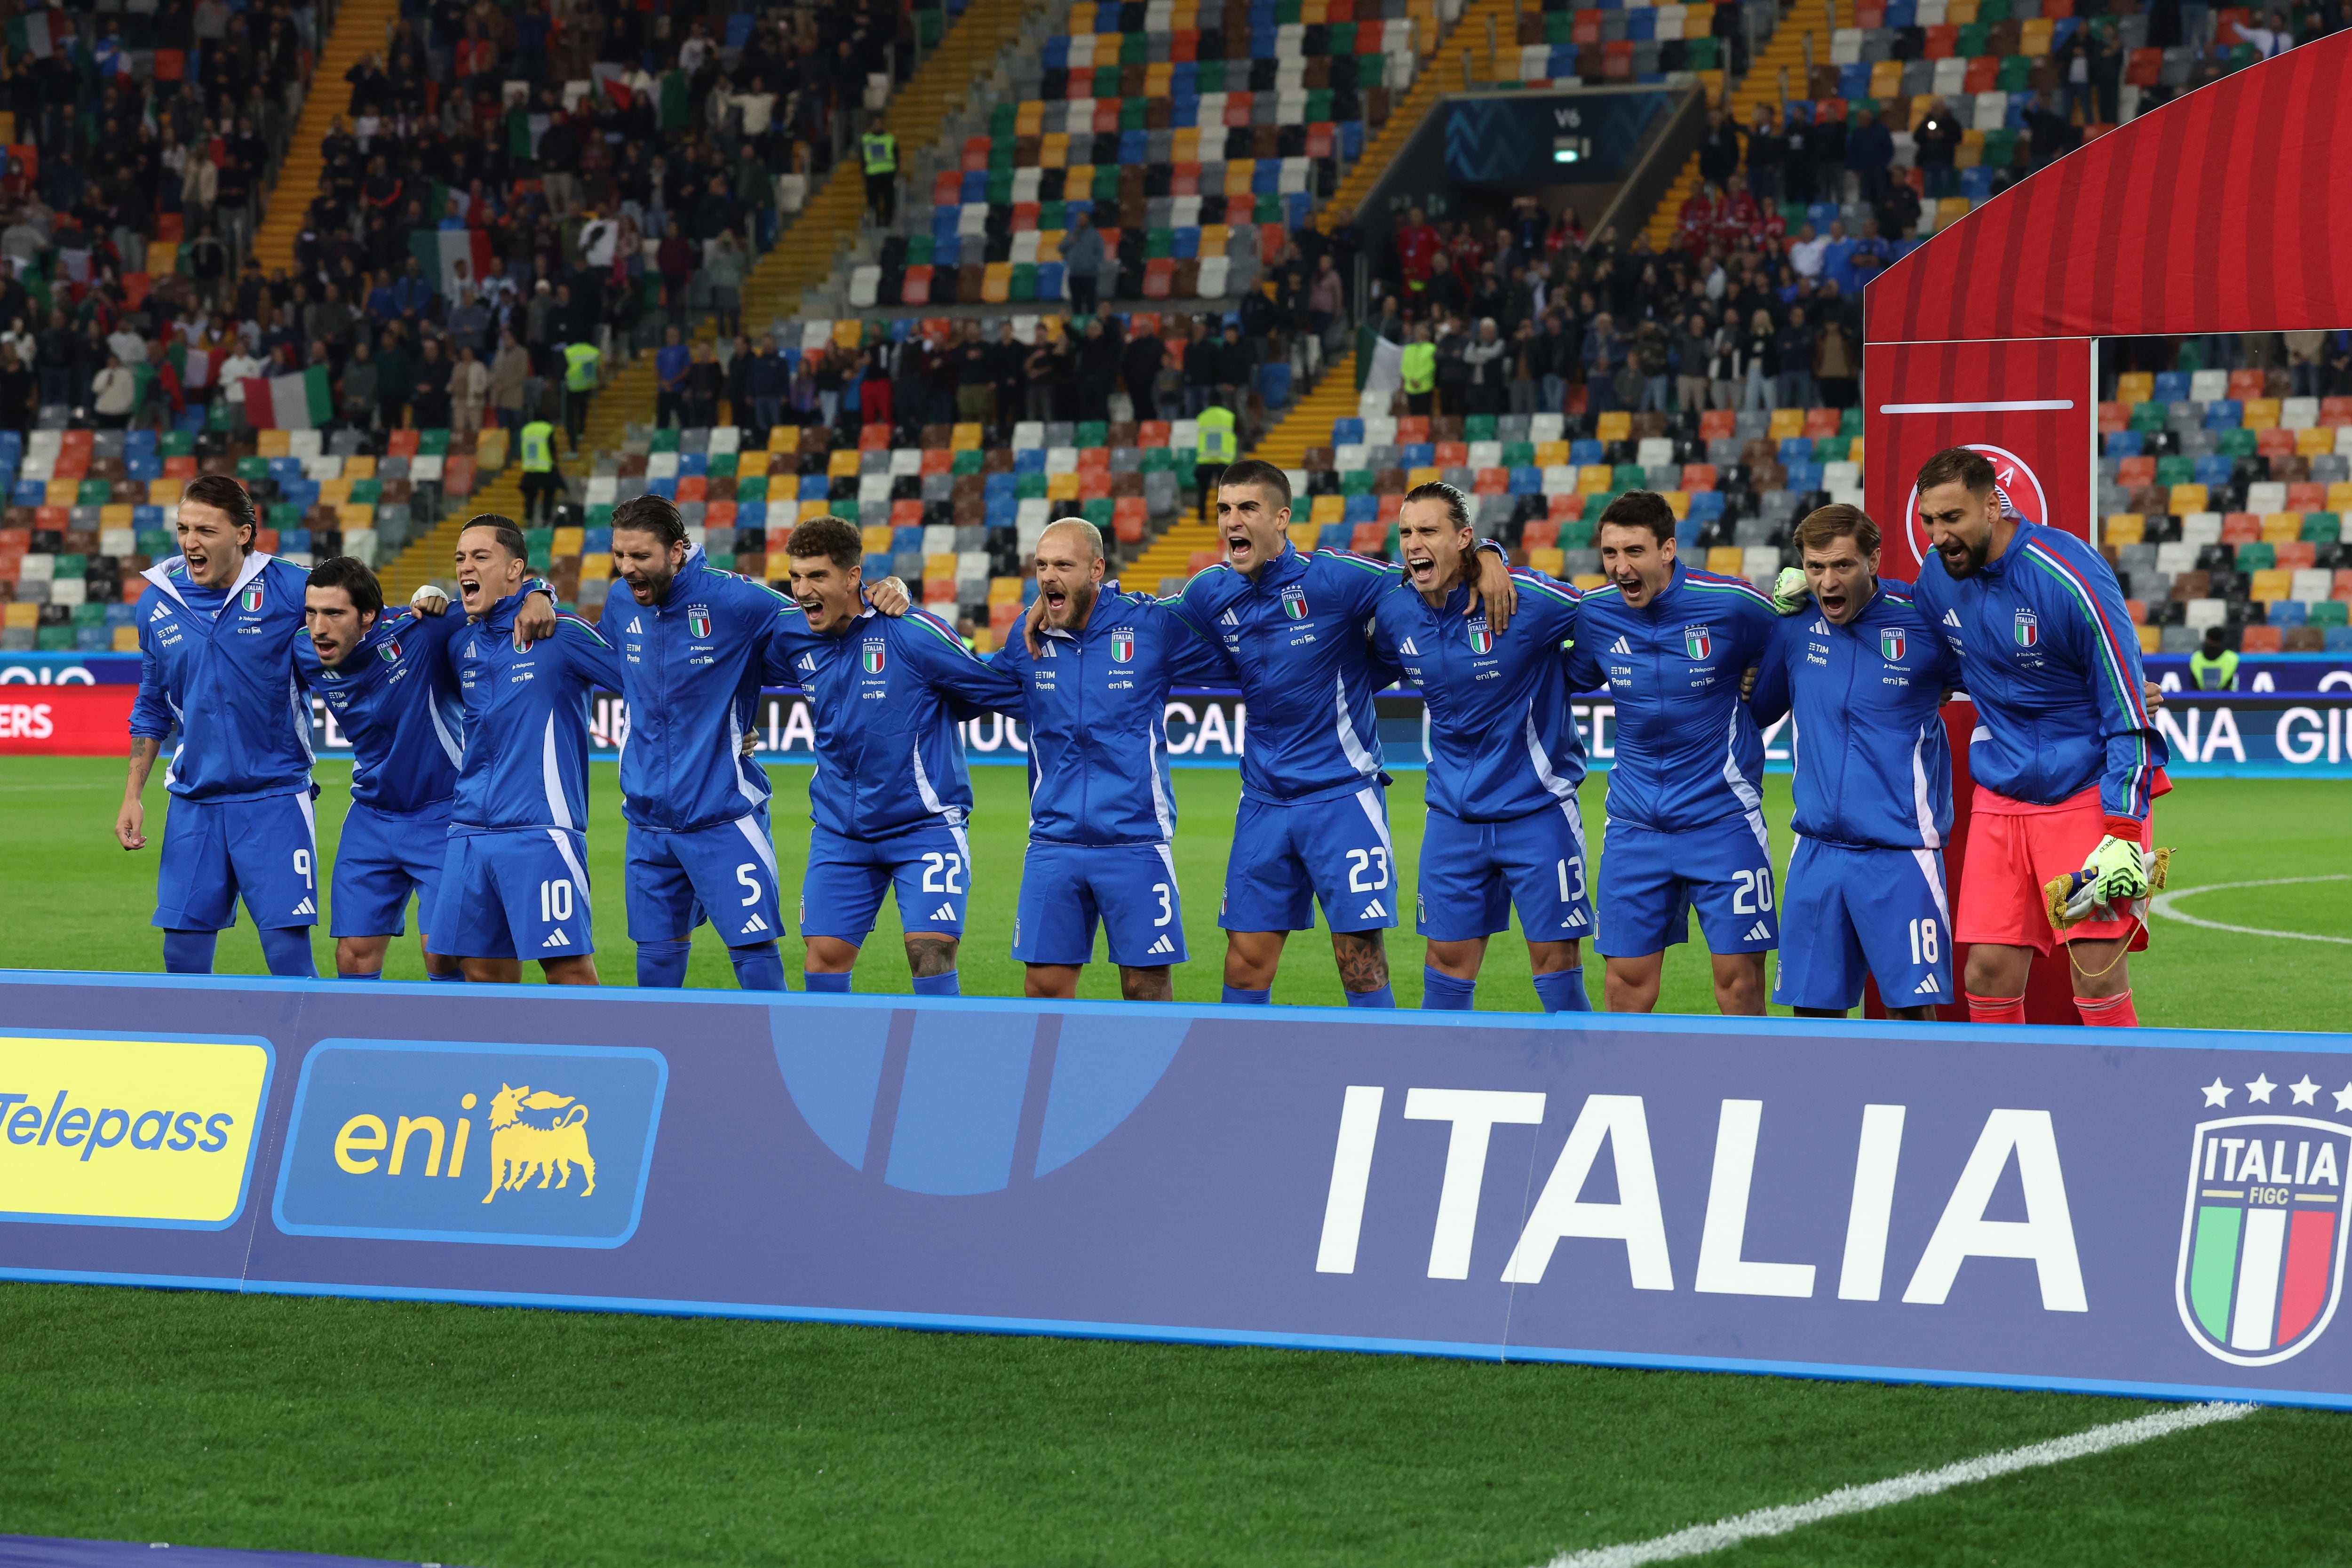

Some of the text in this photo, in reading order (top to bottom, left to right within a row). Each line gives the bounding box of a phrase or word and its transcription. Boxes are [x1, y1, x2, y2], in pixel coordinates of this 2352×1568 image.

[165, 623, 179, 636] TIM
[1294, 623, 1314, 631] Telepass
[1687, 629, 1707, 638] ITALIA
[161, 633, 183, 647] Poste
[378, 640, 395, 650] ITALIA
[1291, 636, 1304, 646] eni
[1953, 637, 1963, 647] TIM
[1816, 644, 1829, 654] TIM
[627, 654, 640, 662] Poste
[1807, 653, 1827, 665] Poste
[389, 672, 400, 684] eni
[512, 673, 524, 683] eni
[1476, 672, 1489, 681] eni
[1611, 677, 1631, 685] Poste
[1691, 678, 1705, 687] eni
[1883, 677, 1898, 685] eni
[1108, 681, 1122, 689] eni
[293, 849, 313, 889] 9
[921, 852, 963, 894] 22
[1345, 846, 1388, 893] 23
[736, 863, 762, 907] 5
[1557, 855, 1586, 902] 13
[1731, 867, 1773, 915] 20
[541, 879, 572, 922] 10
[1152, 883, 1172, 927] 3
[1909, 918, 1939, 965] 18
[0, 1090, 234, 1162] Telepass
[334, 1092, 477, 1178] eni
[2203, 1138, 2339, 1186] ITALIA
[1315, 1085, 2089, 1313] ITALIA
[2249, 1187, 2289, 1205] FIGC
